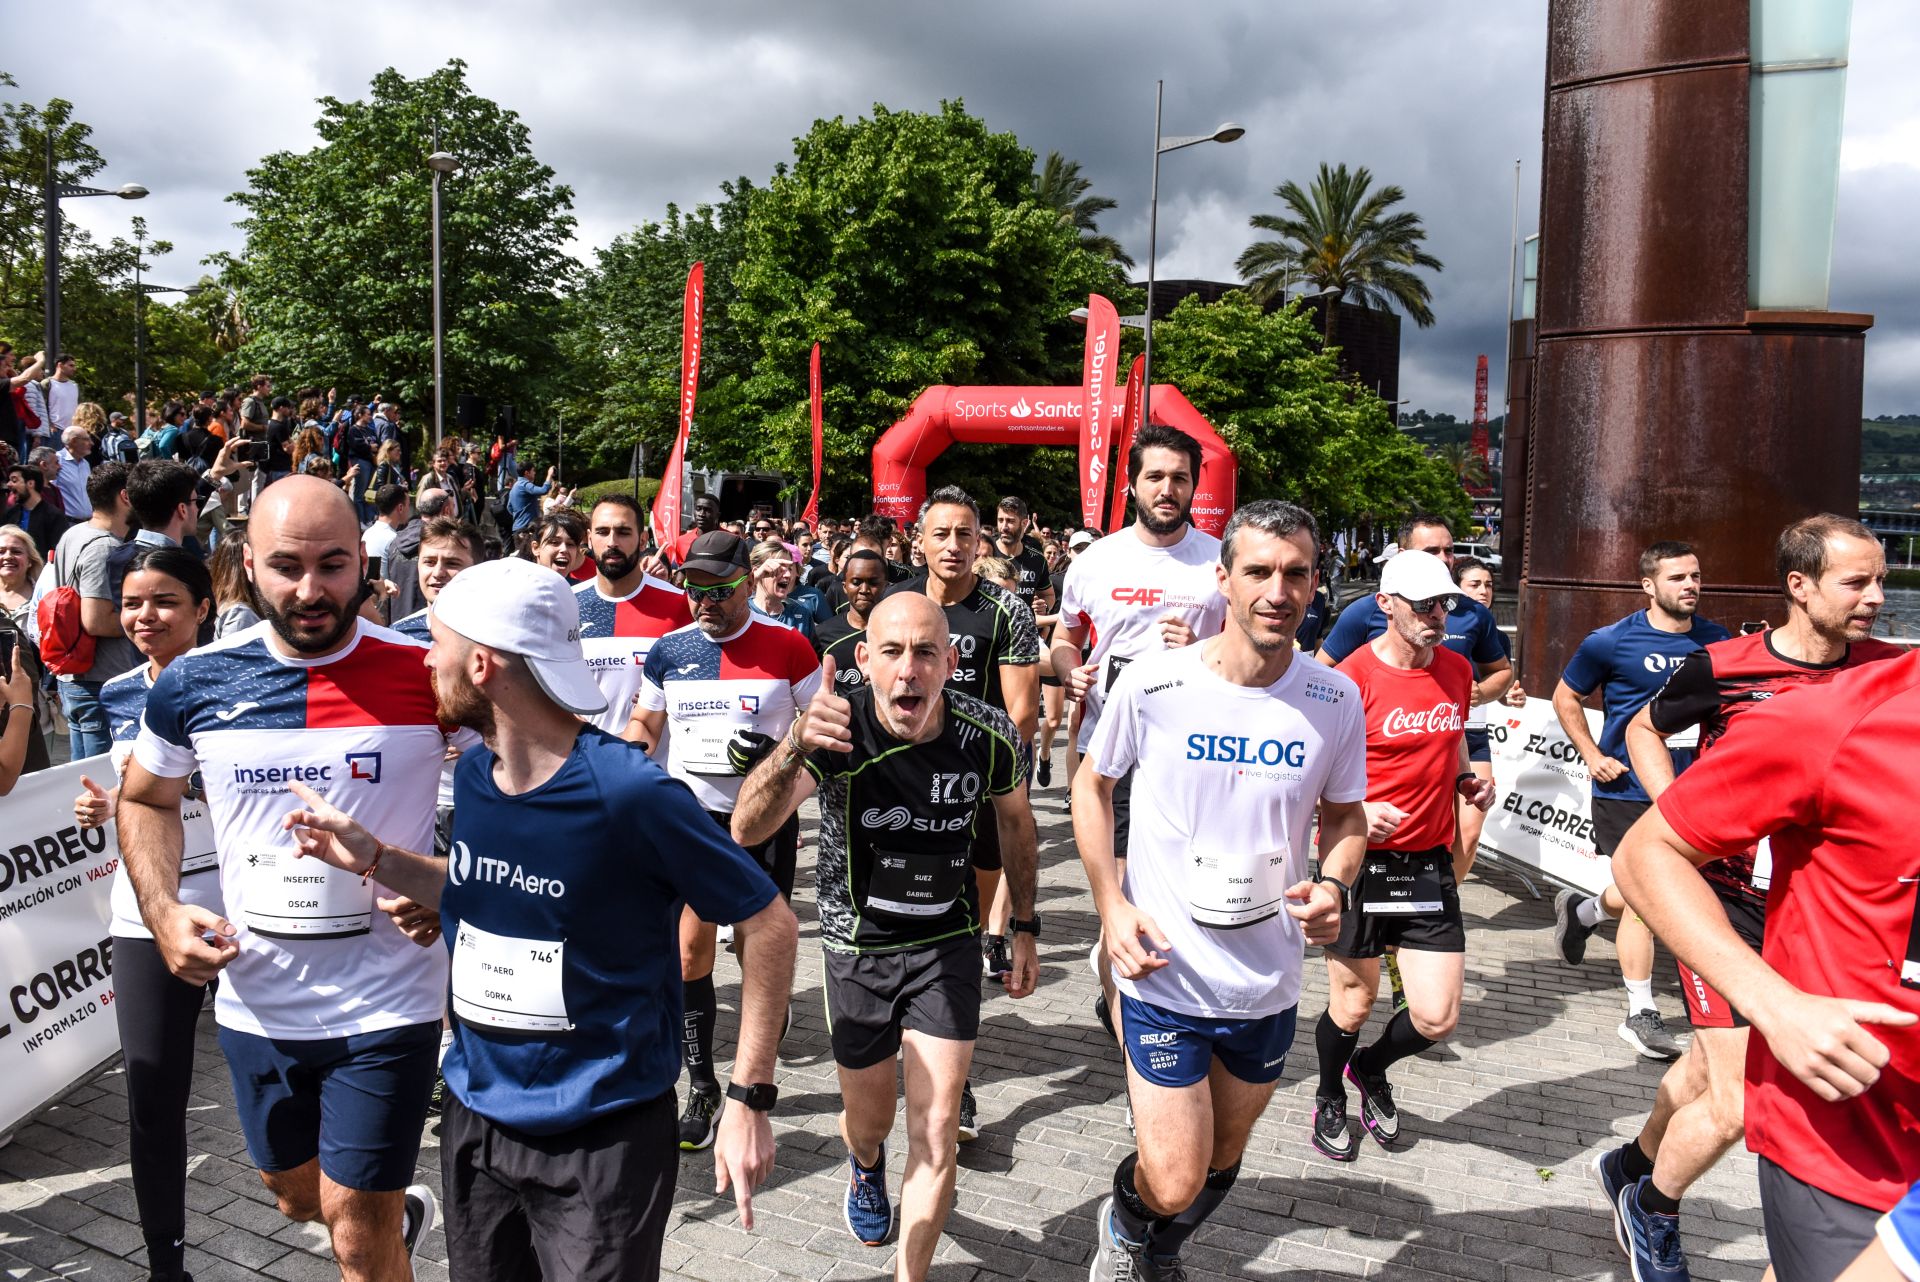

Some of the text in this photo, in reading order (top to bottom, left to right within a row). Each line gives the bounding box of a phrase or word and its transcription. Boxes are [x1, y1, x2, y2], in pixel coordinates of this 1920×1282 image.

[955, 400, 1125, 420] Sports Santaer
[877, 482, 900, 492] Sports
[877, 495, 913, 503] Santander
[1190, 507, 1225, 515] ntander
[1111, 588, 1163, 606] CAF
[1166, 602, 1208, 610] ENGINEERING
[1669, 657, 1686, 668] IT
[1144, 681, 1174, 696] luanvi
[1306, 683, 1345, 698] HARDIS
[1304, 691, 1339, 704] GROUP
[678, 700, 730, 711] insertec
[1383, 702, 1462, 738] Coca-Cola
[1187, 733, 1305, 768] SISLOG
[1523, 734, 1546, 756] EL
[234, 764, 331, 783] insertec
[1245, 769, 1302, 782] live logistics
[930, 773, 940, 803] bilbao
[941, 771, 980, 798] 70
[1503, 792, 1523, 815] EL
[183, 810, 201, 821] 644
[912, 810, 972, 832] suez
[951, 858, 965, 867] 142
[1269, 856, 1283, 866] 706
[283, 876, 325, 884] INSERTEC
[476, 856, 565, 898] ITP Aero
[0, 886, 55, 920] RMACIÓN
[57, 875, 82, 894] CON
[906, 890, 933, 898] GABRIEL
[531, 950, 553, 963] 746
[482, 963, 514, 976] ITP AERO
[485, 990, 512, 1002] GORKA
[22, 1001, 97, 1053] INFORMAZIO
[682, 1010, 703, 1066] Kalenji
[1150, 1054, 1178, 1063] HARDIS
[1151, 1061, 1177, 1070] GROUP
